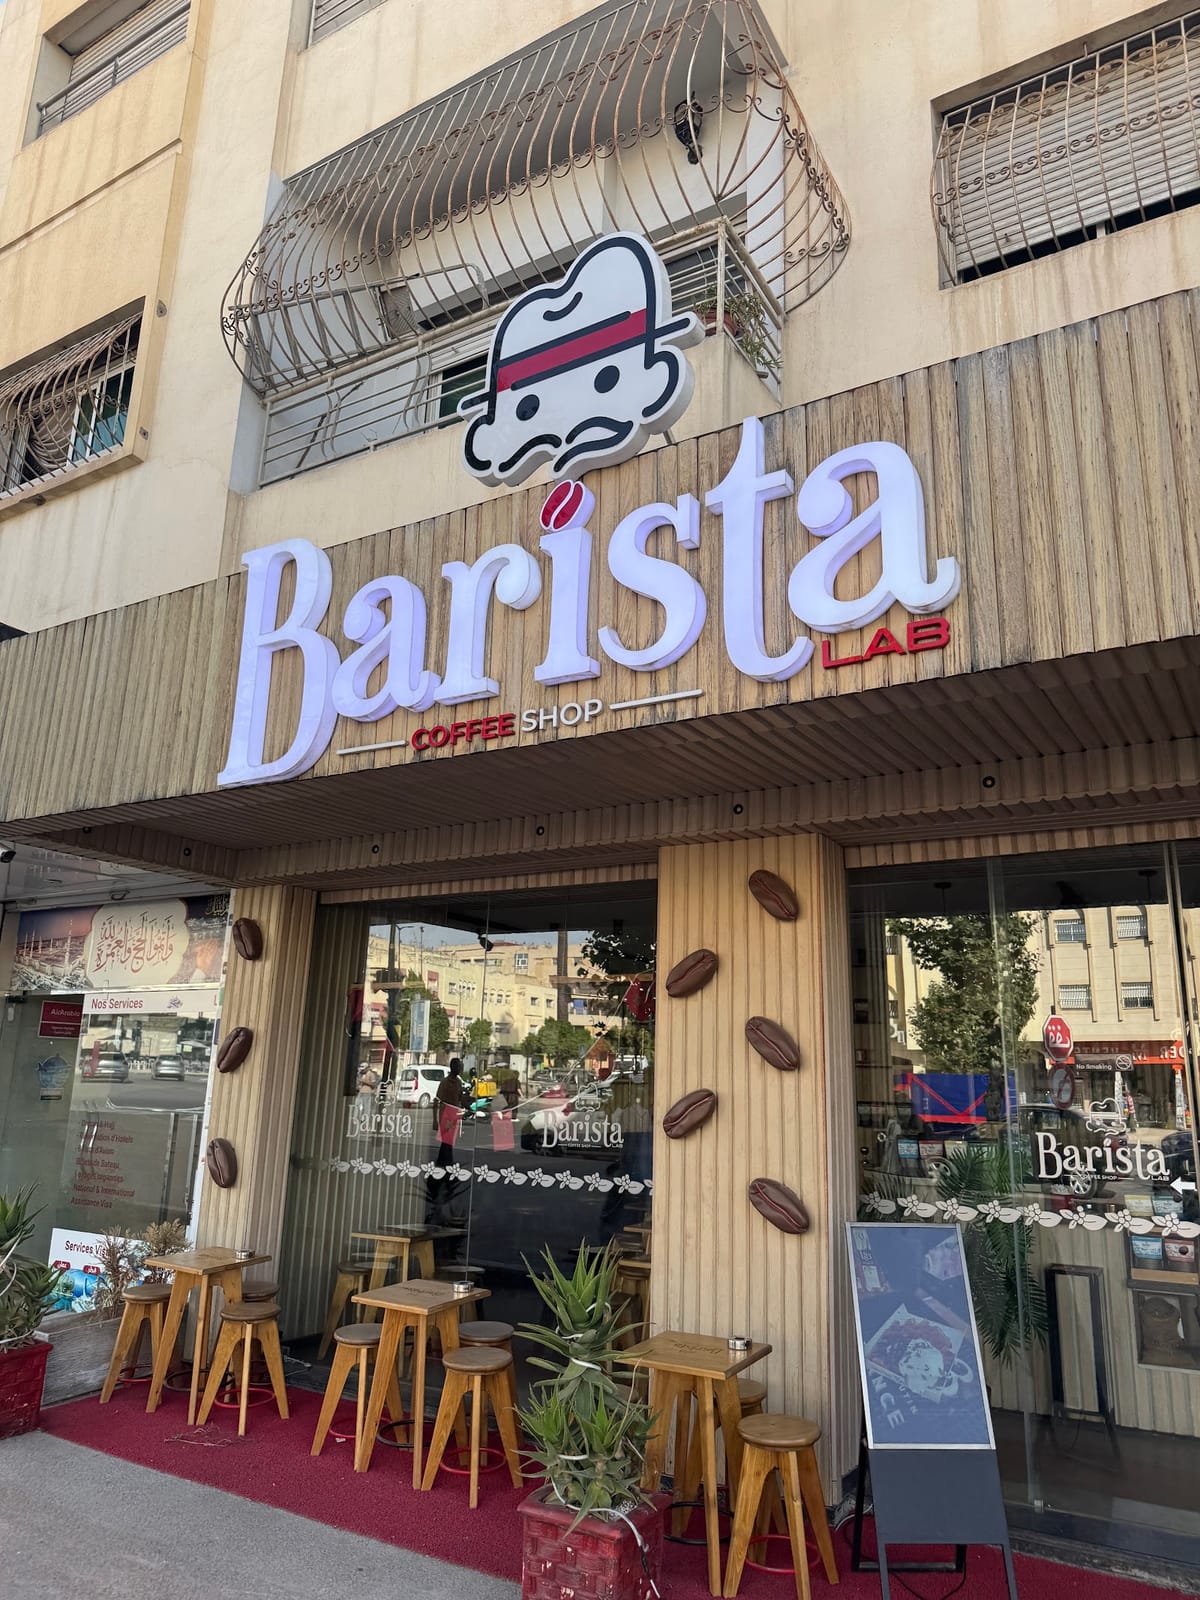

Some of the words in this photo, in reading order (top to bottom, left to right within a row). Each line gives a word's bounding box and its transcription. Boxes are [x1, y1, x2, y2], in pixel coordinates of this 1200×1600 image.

[217, 416, 961, 787] Barista
[822, 617, 950, 670] LAB
[411, 712, 516, 751] COFFEE
[521, 698, 603, 732] SHOP
[91, 999, 108, 1009] Nos
[109, 998, 143, 1009] Services
[346, 1104, 413, 1138] Barista
[541, 1110, 624, 1148] Barista
[1035, 1132, 1170, 1181] Barista
[65, 1240, 93, 1254] Services
